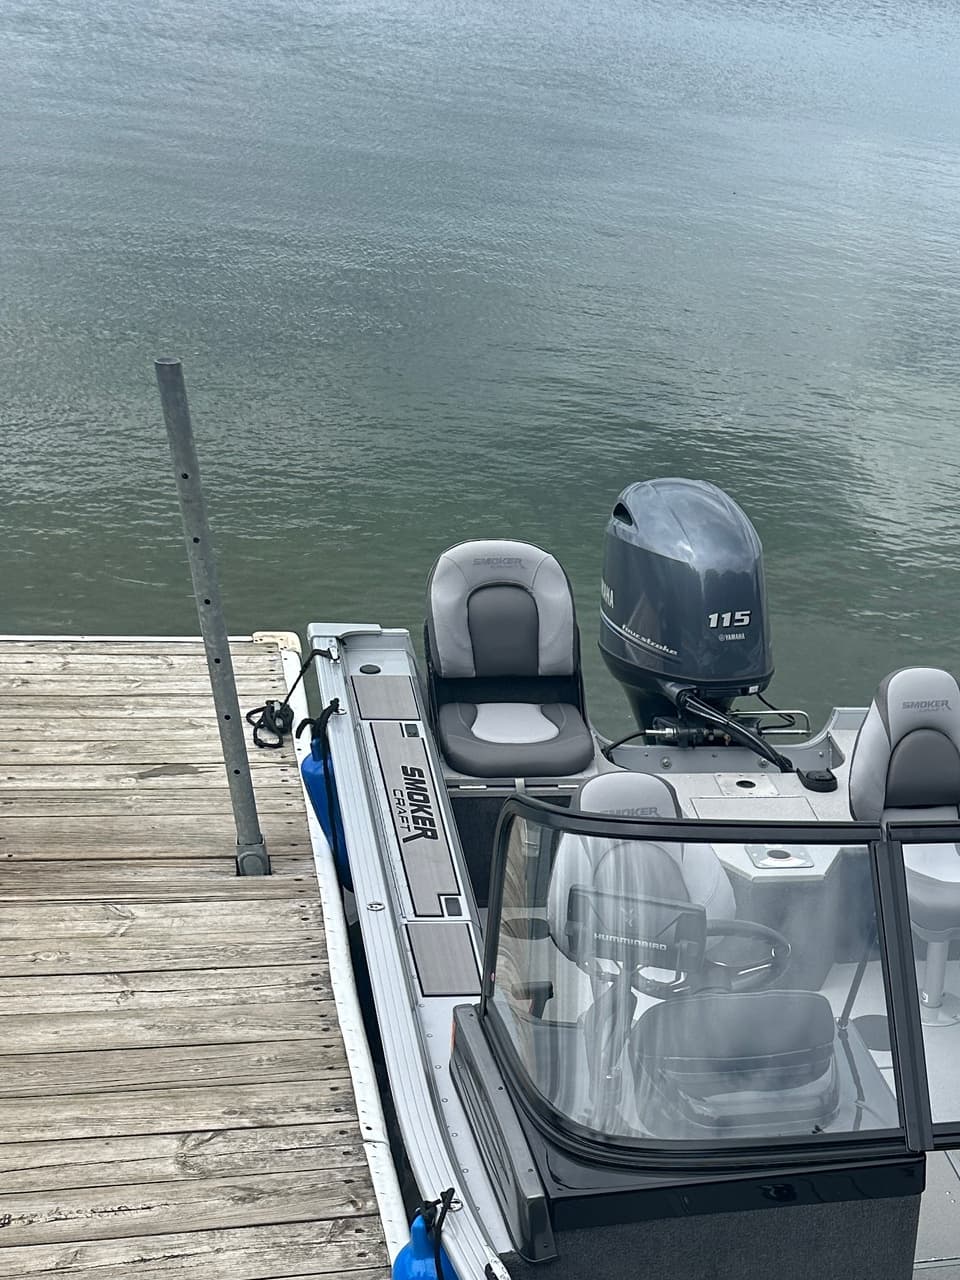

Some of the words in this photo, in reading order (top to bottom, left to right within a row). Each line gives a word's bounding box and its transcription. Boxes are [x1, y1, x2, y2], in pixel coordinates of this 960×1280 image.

[708, 610, 751, 628] 115
[902, 699, 952, 711] SMOKER
[392, 788, 411, 833] CRAFT
[400, 765, 439, 844] SMOKER
